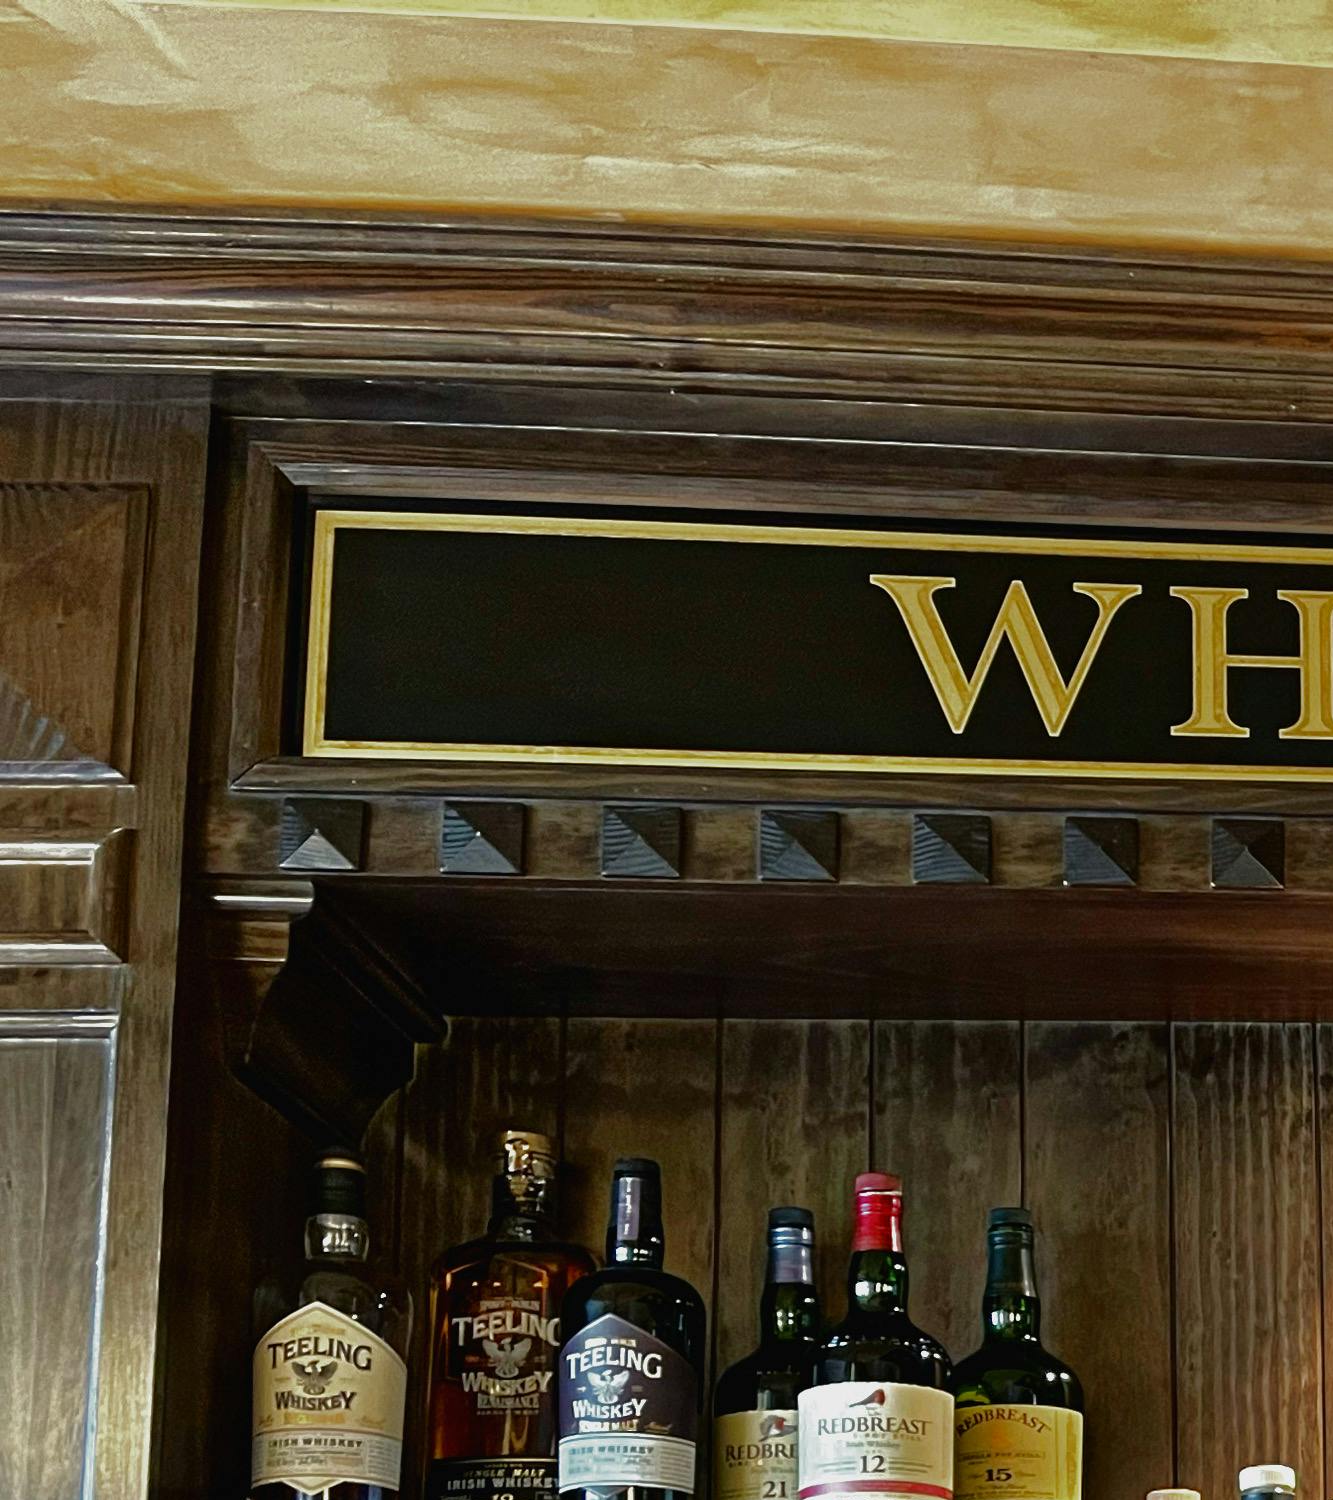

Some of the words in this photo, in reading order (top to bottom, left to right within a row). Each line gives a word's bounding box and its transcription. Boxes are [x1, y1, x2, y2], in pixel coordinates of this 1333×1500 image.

[452, 1315, 560, 1346] TEELING
[267, 1336, 373, 1370] TEELING
[566, 1350, 662, 1379] TEELING
[461, 1371, 554, 1395] WHISKEY
[274, 1391, 358, 1412] WHISKEY
[572, 1398, 647, 1420] WHISKEY
[817, 1417, 934, 1436] REDBREAST
[956, 1408, 1052, 1437] REDBREAST
[268, 1439, 298, 1448] IRISH
[302, 1439, 363, 1448] WHISKEY
[725, 1443, 799, 1463] REDBRE
[859, 1455, 886, 1474] 12
[447, 1479, 488, 1491] IRISH
[491, 1477, 560, 1490] WHISKEY
[985, 1469, 1012, 1482] 15
[763, 1480, 787, 1499] 21
